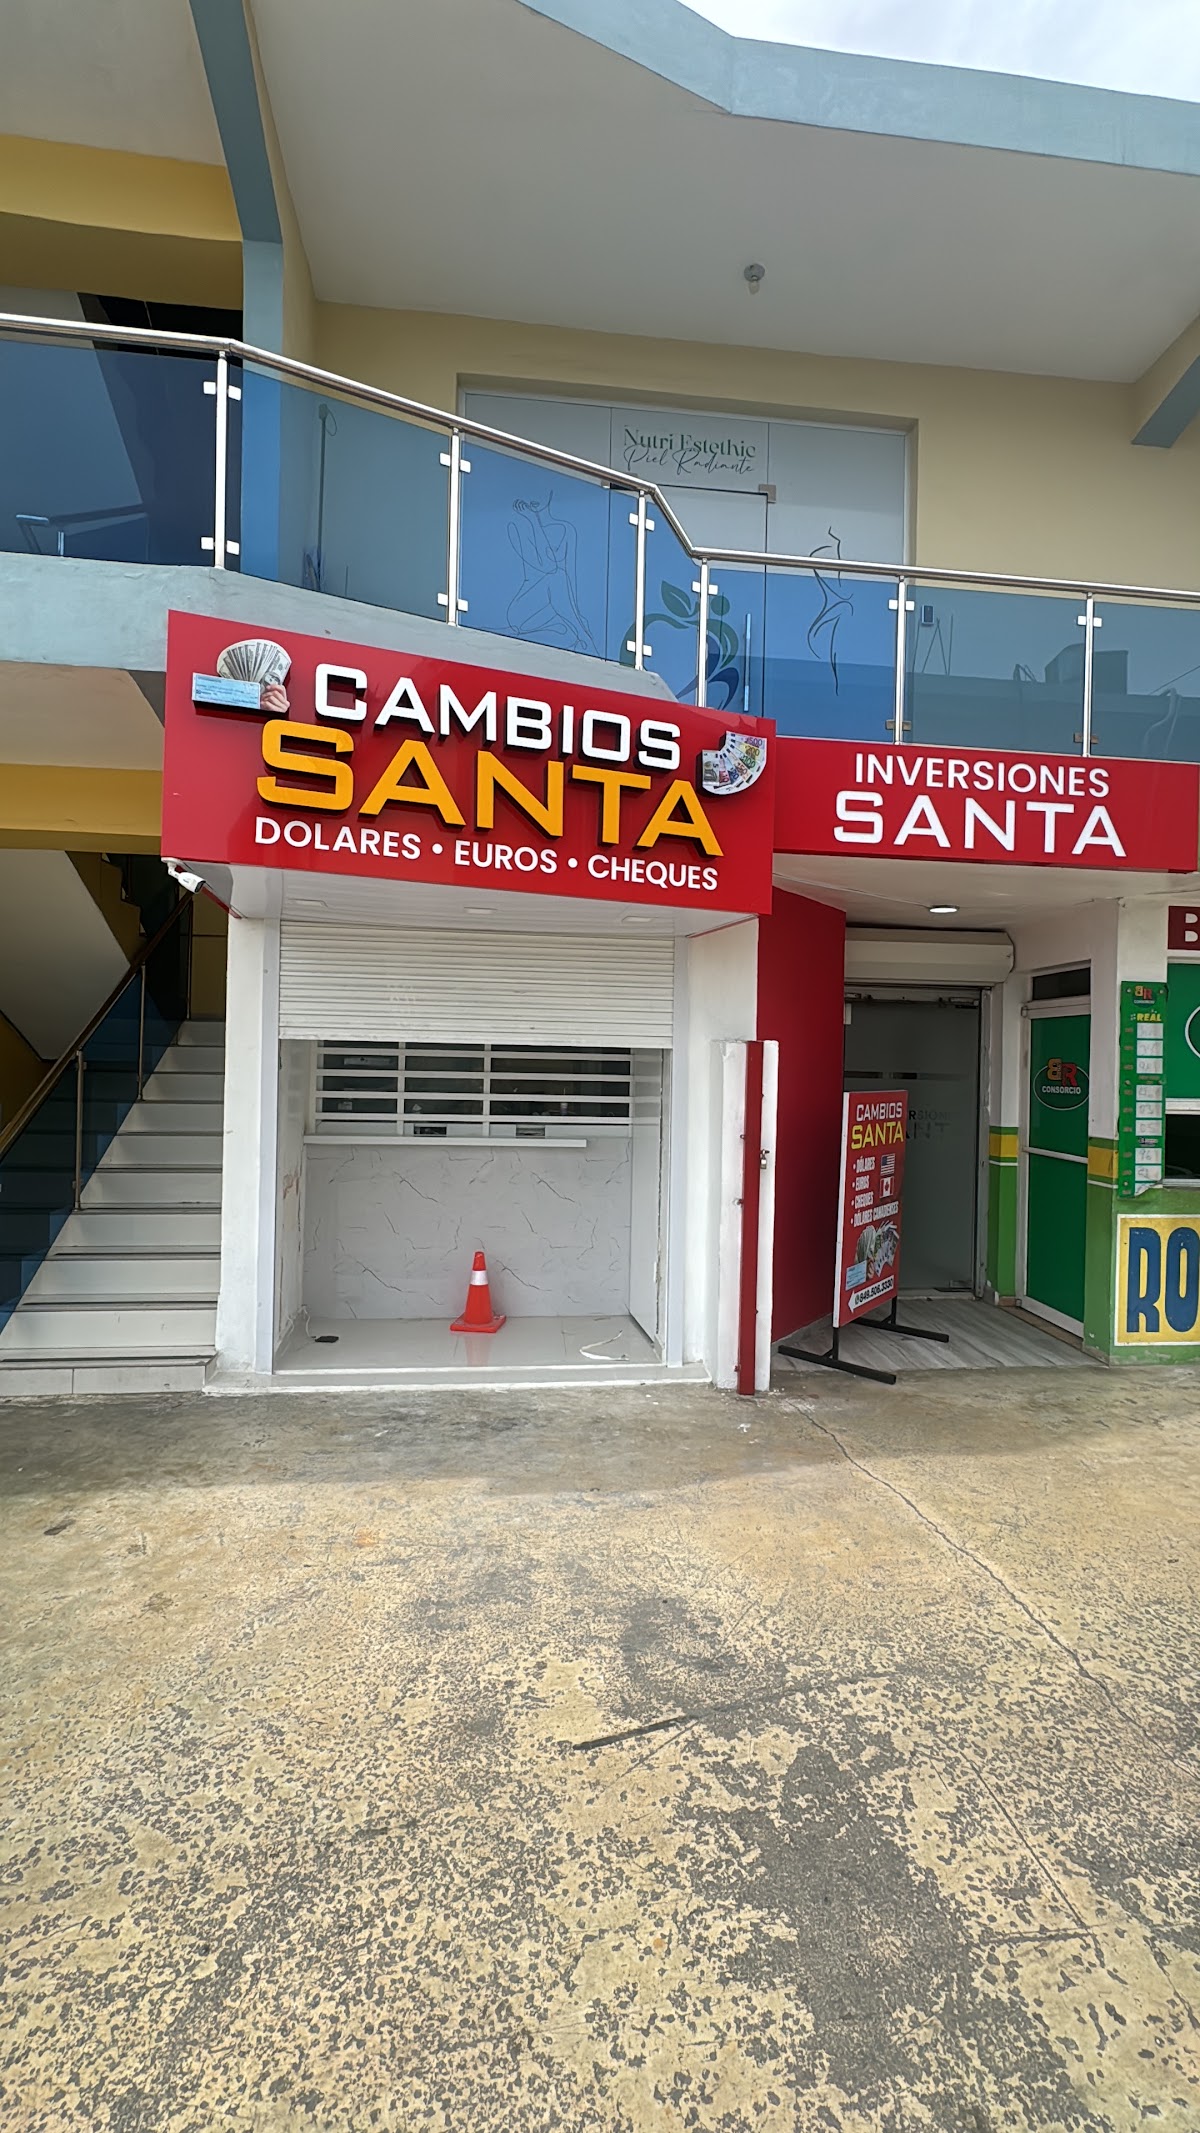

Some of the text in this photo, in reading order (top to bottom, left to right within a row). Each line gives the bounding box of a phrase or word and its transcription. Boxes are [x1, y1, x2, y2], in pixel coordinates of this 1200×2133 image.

[624, 425, 673, 450] Nutri
[624, 444, 755, 475] Piel Radiante
[315, 663, 681, 770] CAMBIOS
[256, 719, 724, 857] SANTA
[855, 753, 1110, 798] INVERSIONES
[833, 790, 1127, 857] SANTA
[255, 816, 718, 890] DOLARES EUROS CHEQUES
[1136, 1013, 1162, 1022] REAL
[1042, 1086, 1082, 1095] CONSORCIO
[856, 1102, 902, 1122] CAMBIOS
[851, 1121, 904, 1149] SANTA
